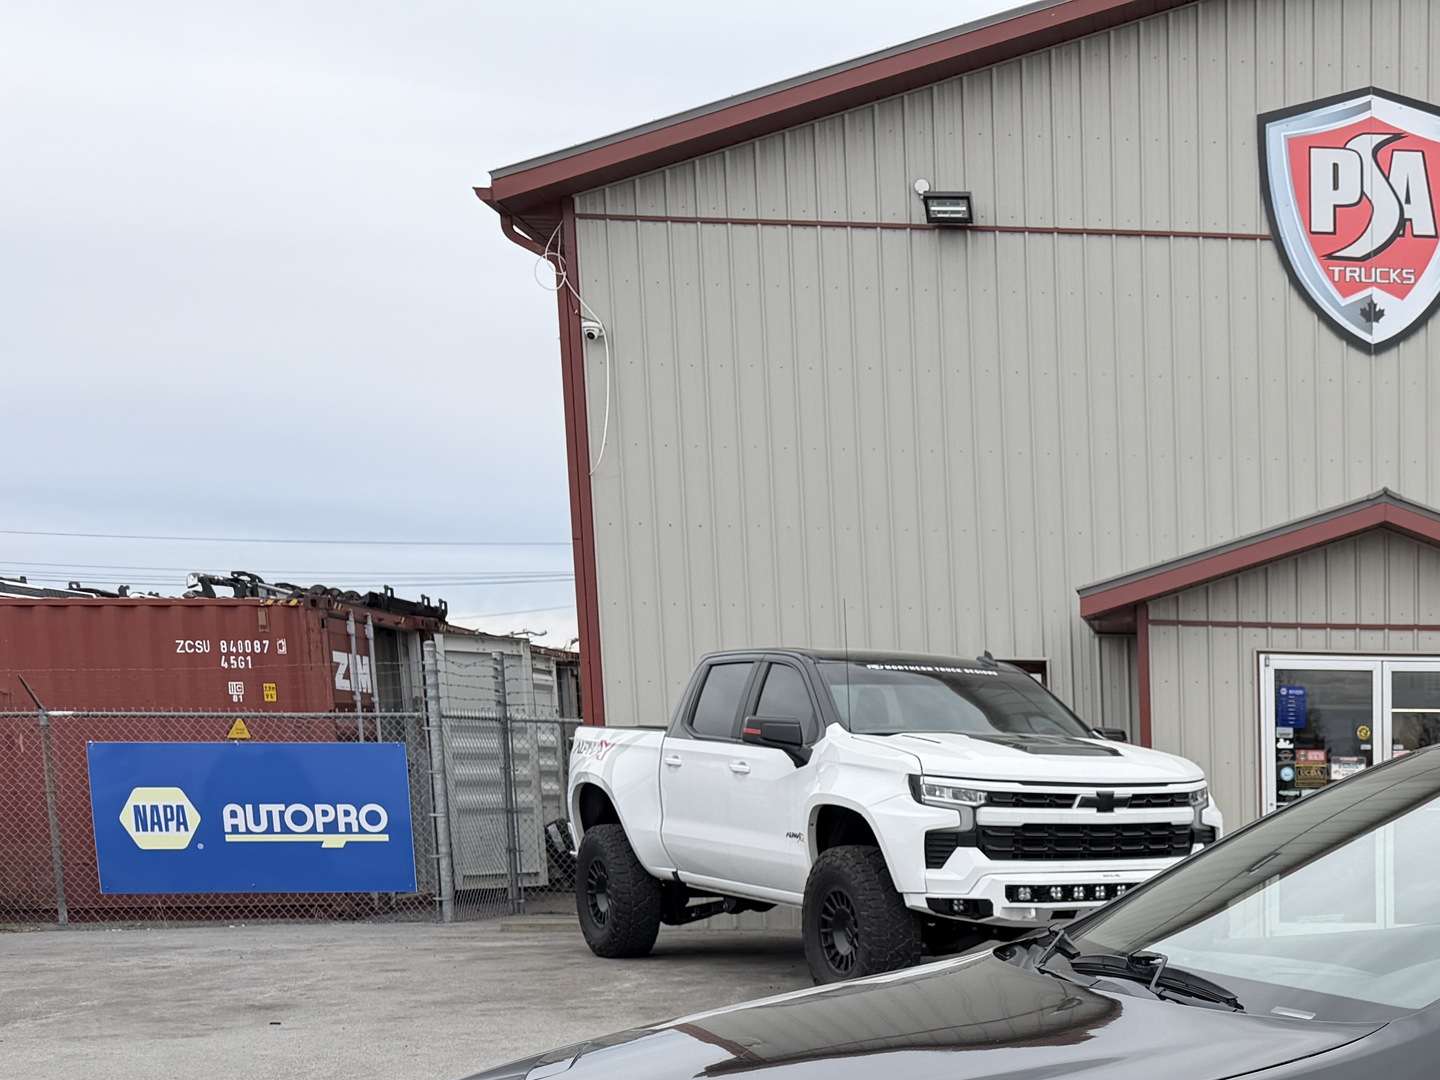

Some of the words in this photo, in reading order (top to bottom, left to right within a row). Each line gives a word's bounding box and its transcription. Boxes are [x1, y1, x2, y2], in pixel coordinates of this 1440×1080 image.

[1308, 132, 1439, 262] PSA
[1328, 266, 1415, 284] TRUCKS
[175, 640, 210, 654] ZCSU
[220, 640, 269, 654] 840087
[221, 656, 252, 669] 45G1
[133, 804, 189, 832] NAPA
[222, 803, 389, 833] AUTOPRO
